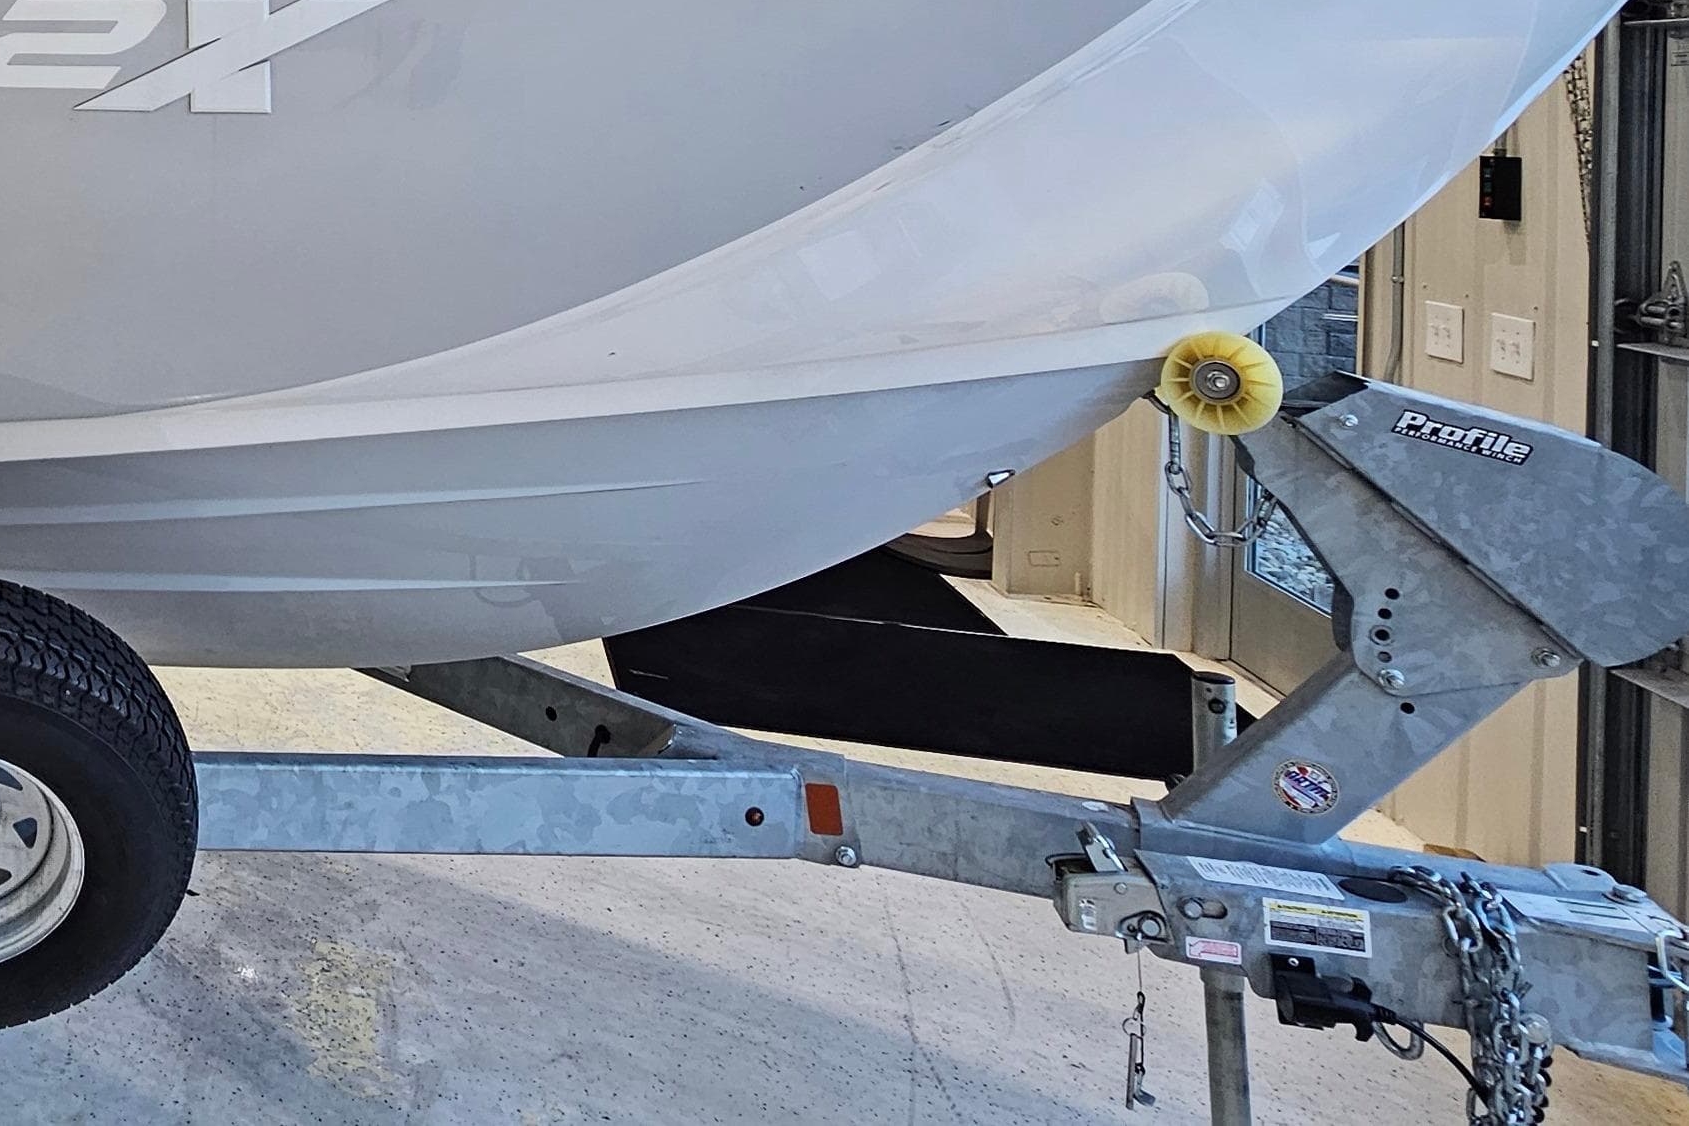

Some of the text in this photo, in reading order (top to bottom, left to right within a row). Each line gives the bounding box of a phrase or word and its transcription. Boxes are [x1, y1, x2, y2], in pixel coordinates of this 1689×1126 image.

[1393, 427, 1523, 464] PERFORMANCE WINCH
[1397, 411, 1531, 458] Profile
